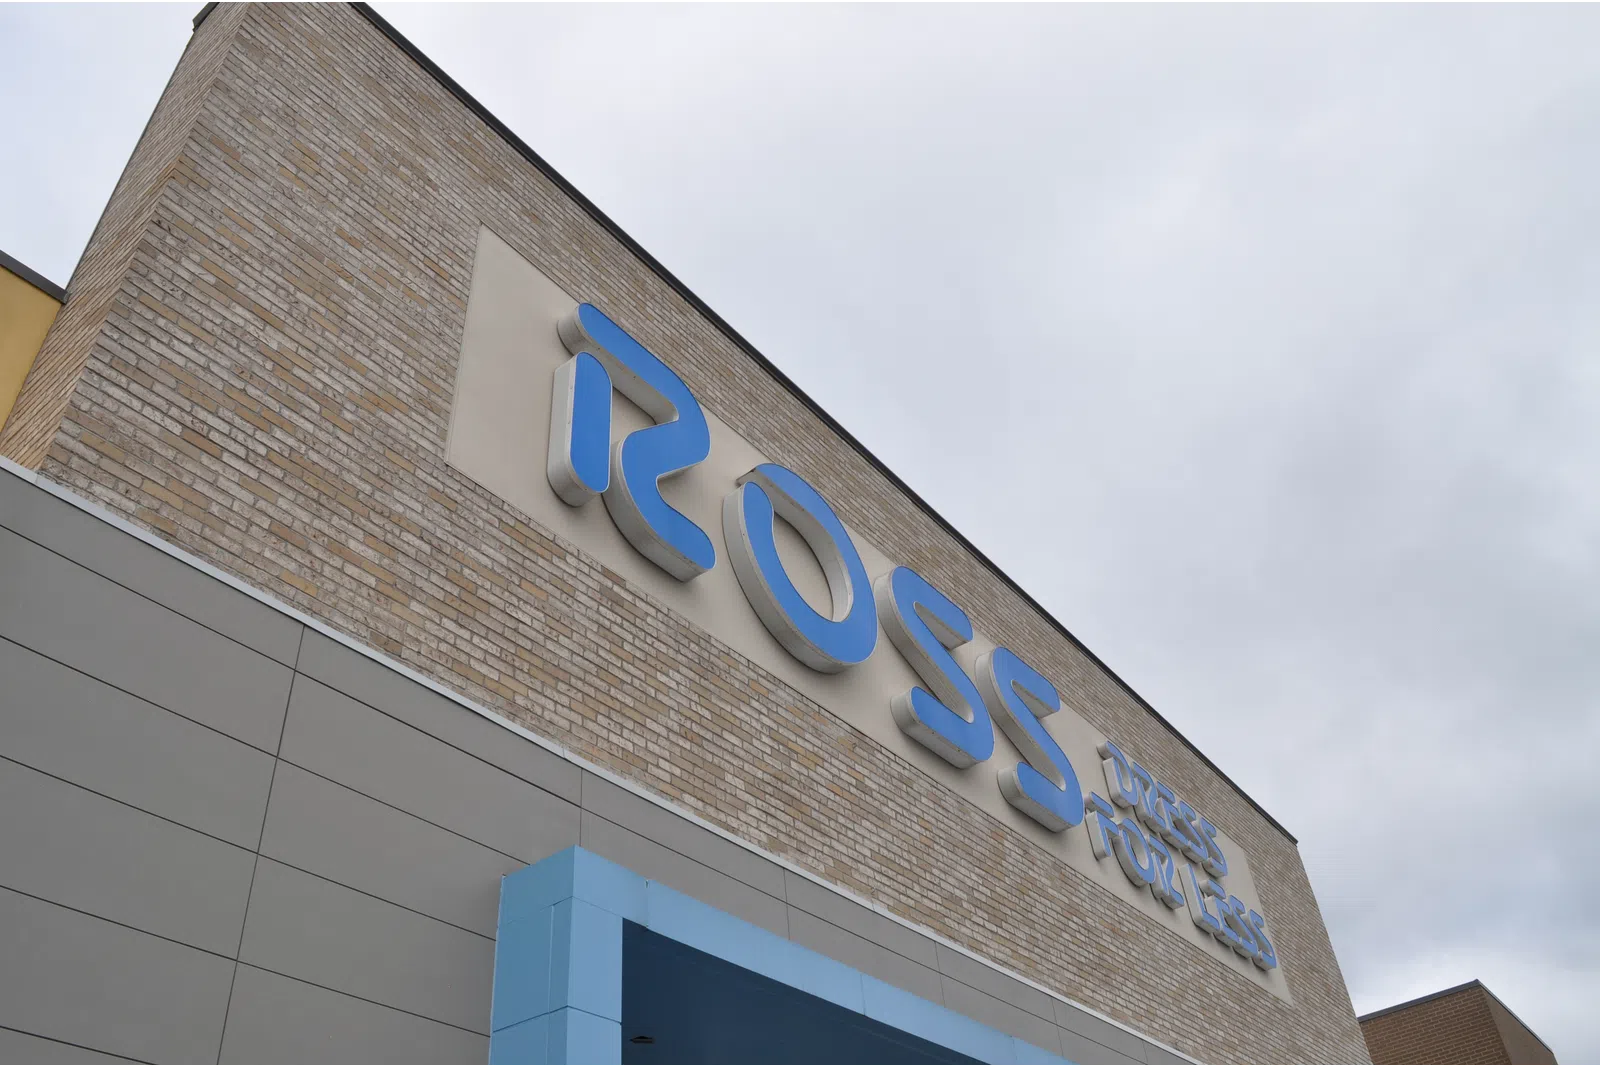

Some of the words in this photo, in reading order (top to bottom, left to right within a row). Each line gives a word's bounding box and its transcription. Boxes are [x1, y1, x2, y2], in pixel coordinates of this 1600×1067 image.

[549, 303, 1084, 831] ROSS
[1086, 791, 1185, 908] FOR
[1179, 864, 1277, 970] LESS
[1099, 741, 1228, 876] DRESS
